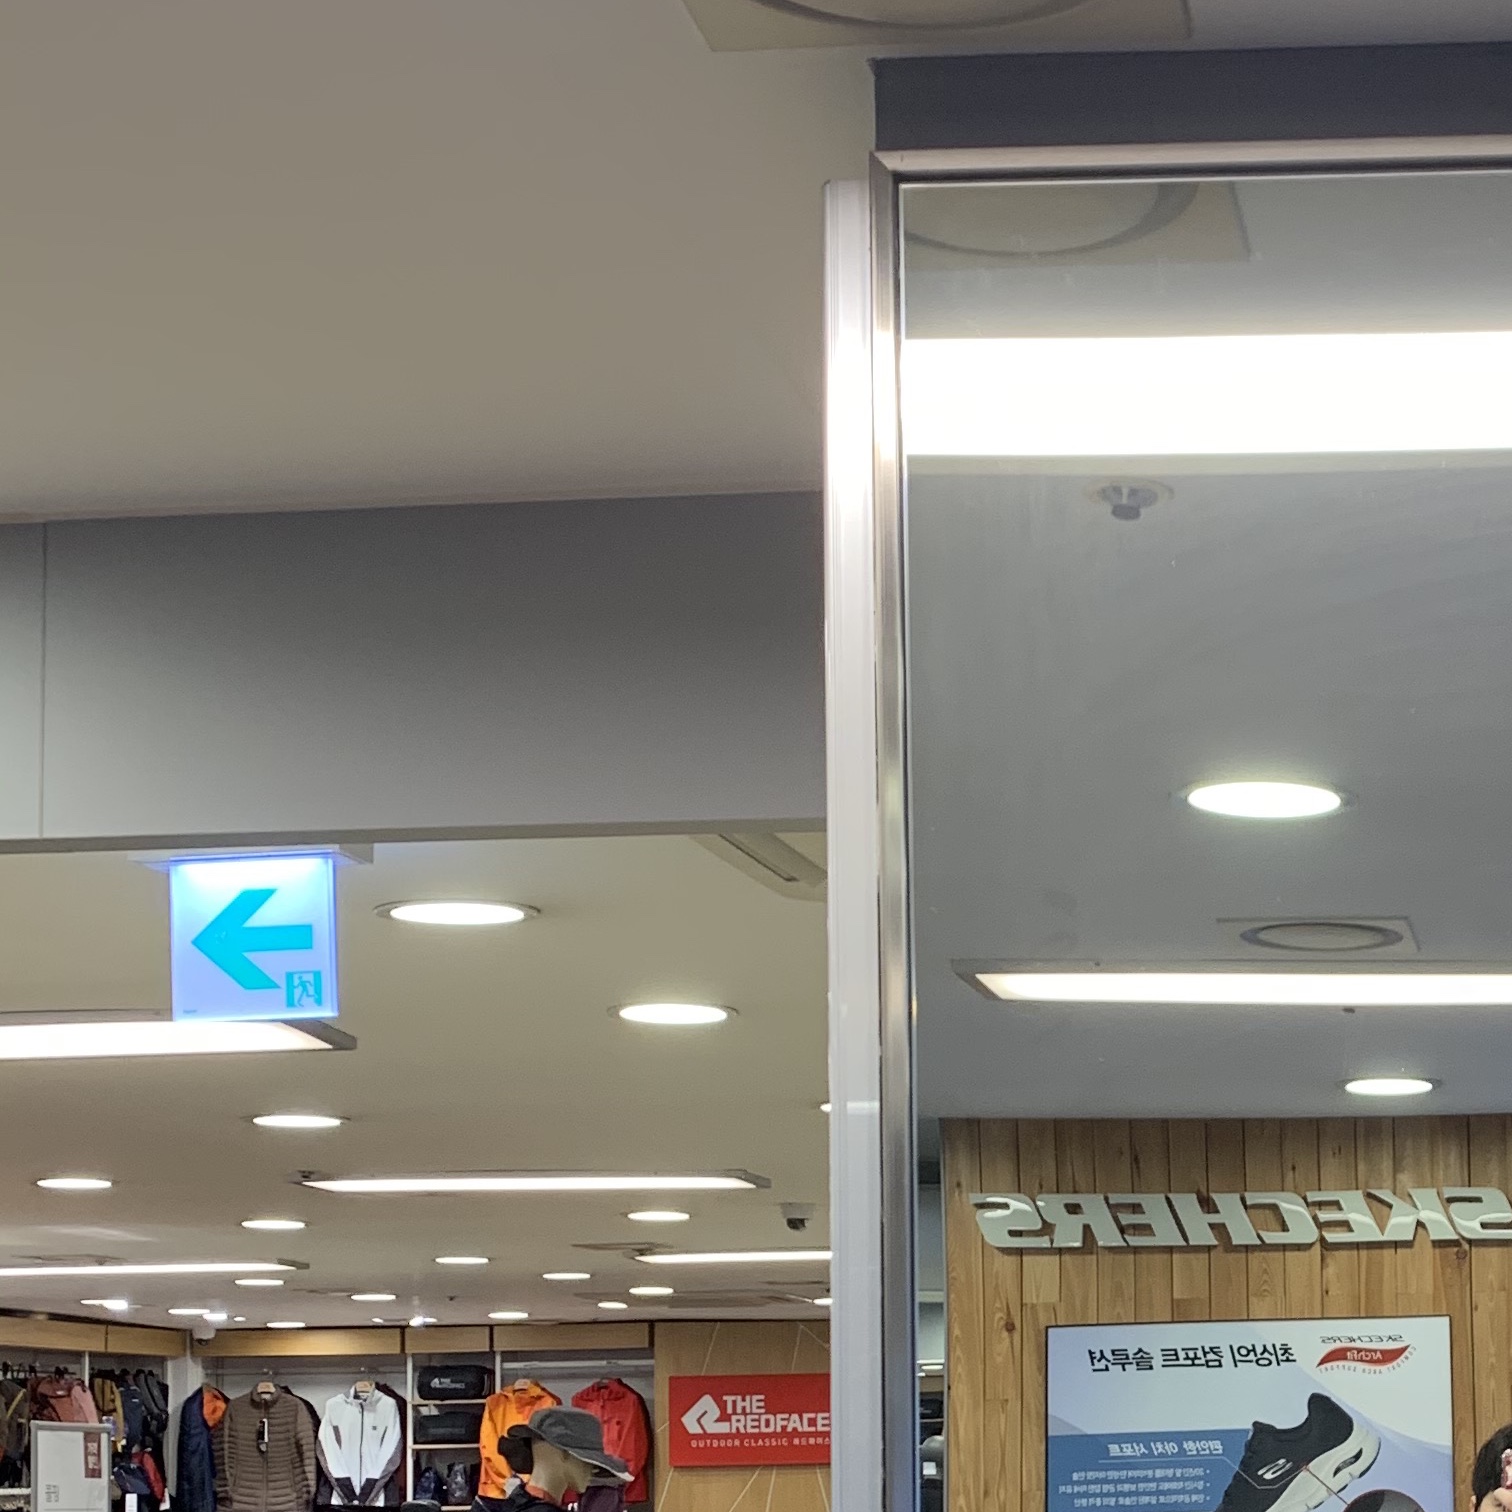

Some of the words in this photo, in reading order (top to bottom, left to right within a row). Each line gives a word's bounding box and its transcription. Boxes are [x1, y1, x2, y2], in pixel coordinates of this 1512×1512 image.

[723, 1395, 766, 1414] THE
[731, 1412, 831, 1433] REDFACE
[691, 1438, 740, 1448] OUTDOOR
[743, 1437, 788, 1447] CLASSIC
